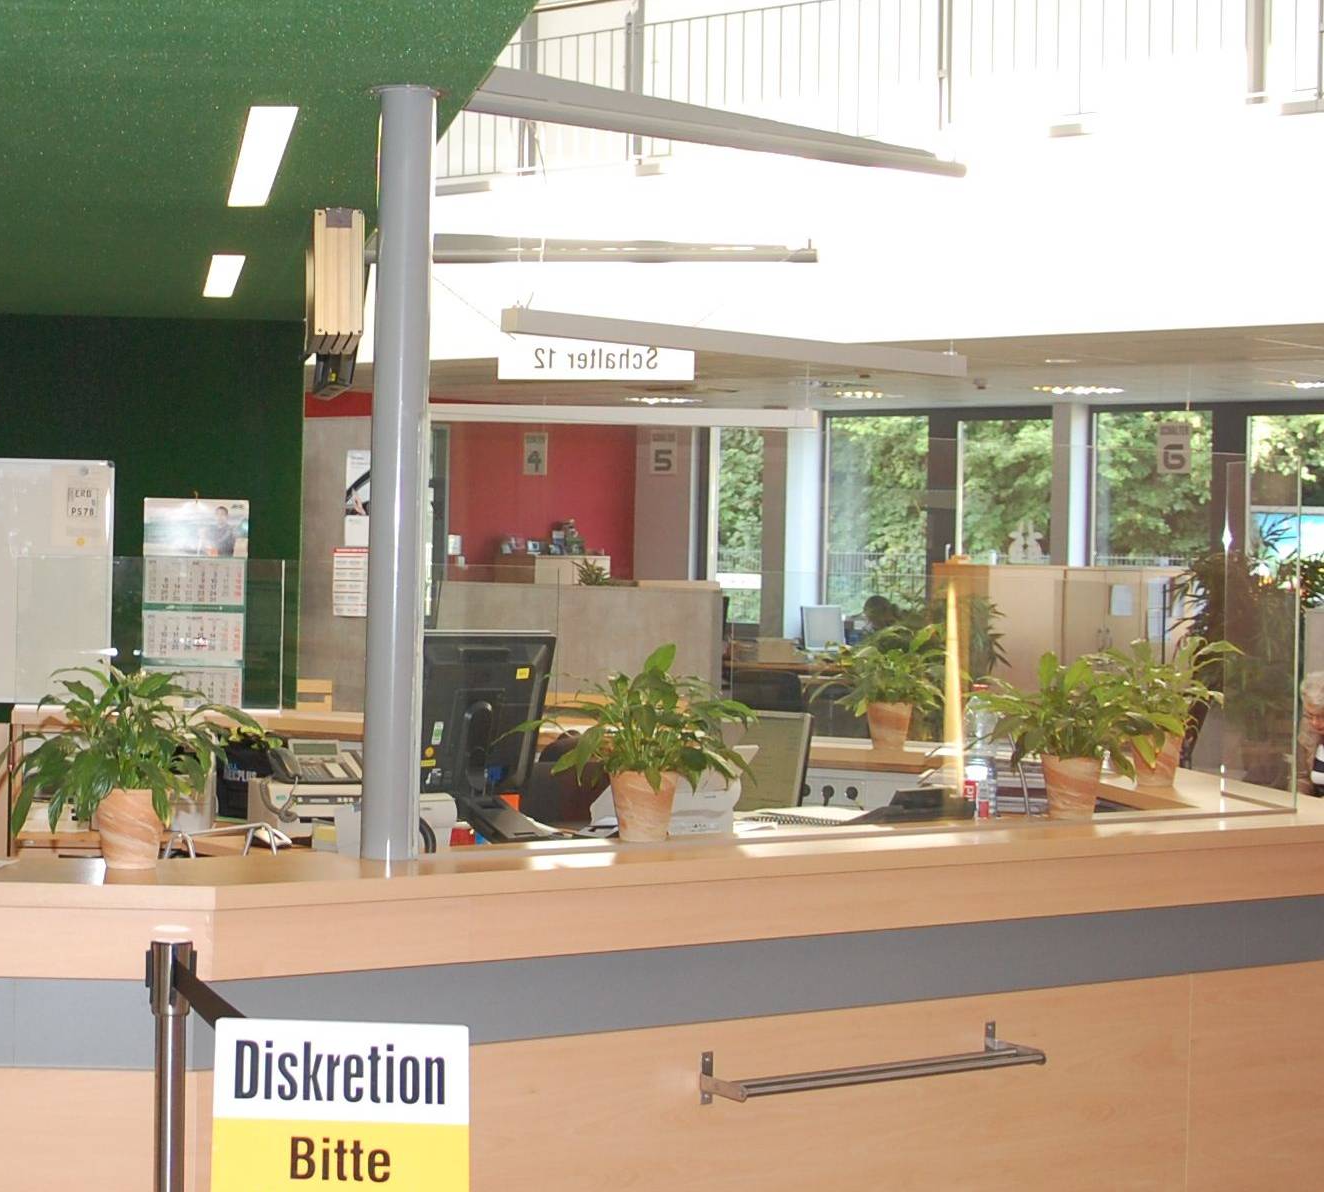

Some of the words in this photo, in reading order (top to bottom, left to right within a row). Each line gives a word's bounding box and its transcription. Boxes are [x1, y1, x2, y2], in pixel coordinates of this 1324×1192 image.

[527, 450, 542, 472] 4
[654, 449, 673, 472] 5
[1163, 443, 1186, 470] 6
[234, 1040, 446, 1105] Diskretion
[290, 1136, 392, 1183] Bitte
